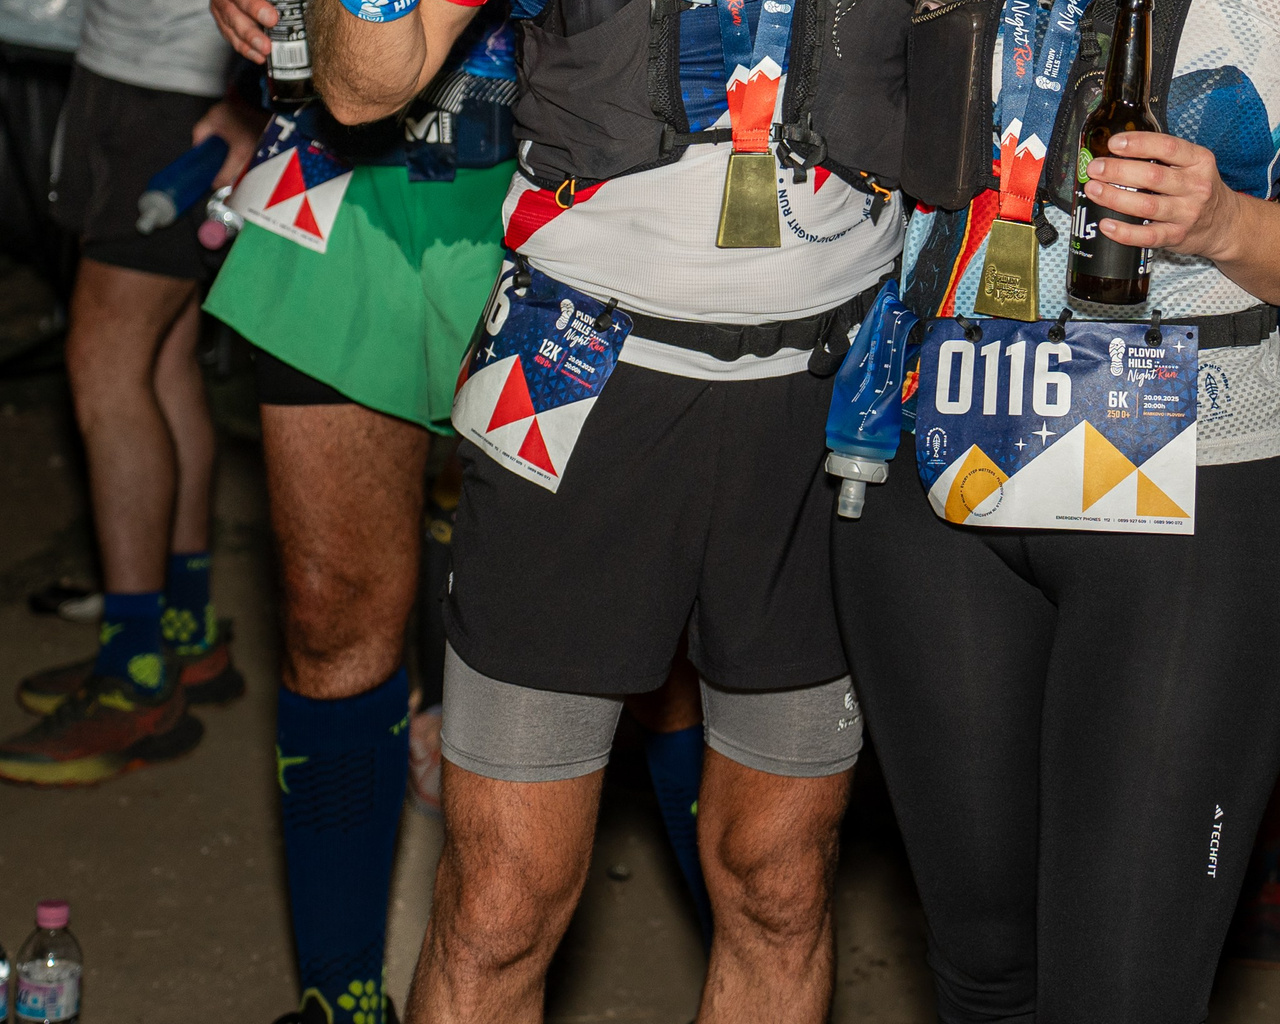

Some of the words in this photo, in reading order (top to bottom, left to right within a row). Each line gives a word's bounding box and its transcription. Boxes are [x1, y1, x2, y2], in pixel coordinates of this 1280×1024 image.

[1004, 0, 1031, 45] Night
[1013, 43, 1032, 79] Run
[1044, 48, 1056, 76] PLOVDIV
[1051, 58, 1061, 78] HILLS
[778, 189, 793, 218] RUN
[787, 218, 819, 243] NIGHT
[571, 319, 592, 337] HILLS
[538, 338, 563, 362] 12K
[563, 328, 590, 348] Night
[587, 336, 605, 353] Run
[567, 354, 596, 374] 20.09.2025
[1128, 348, 1165, 359] PLOVDIV
[1128, 359, 1152, 368] HILLS
[935, 340, 1072, 417] 0116
[1127, 369, 1157, 387] Night
[1155, 366, 1178, 380] Run
[1108, 390, 1128, 408] 6K
[1107, 410, 1120, 418] 250
[1207, 822, 1222, 878] TECHFIT
